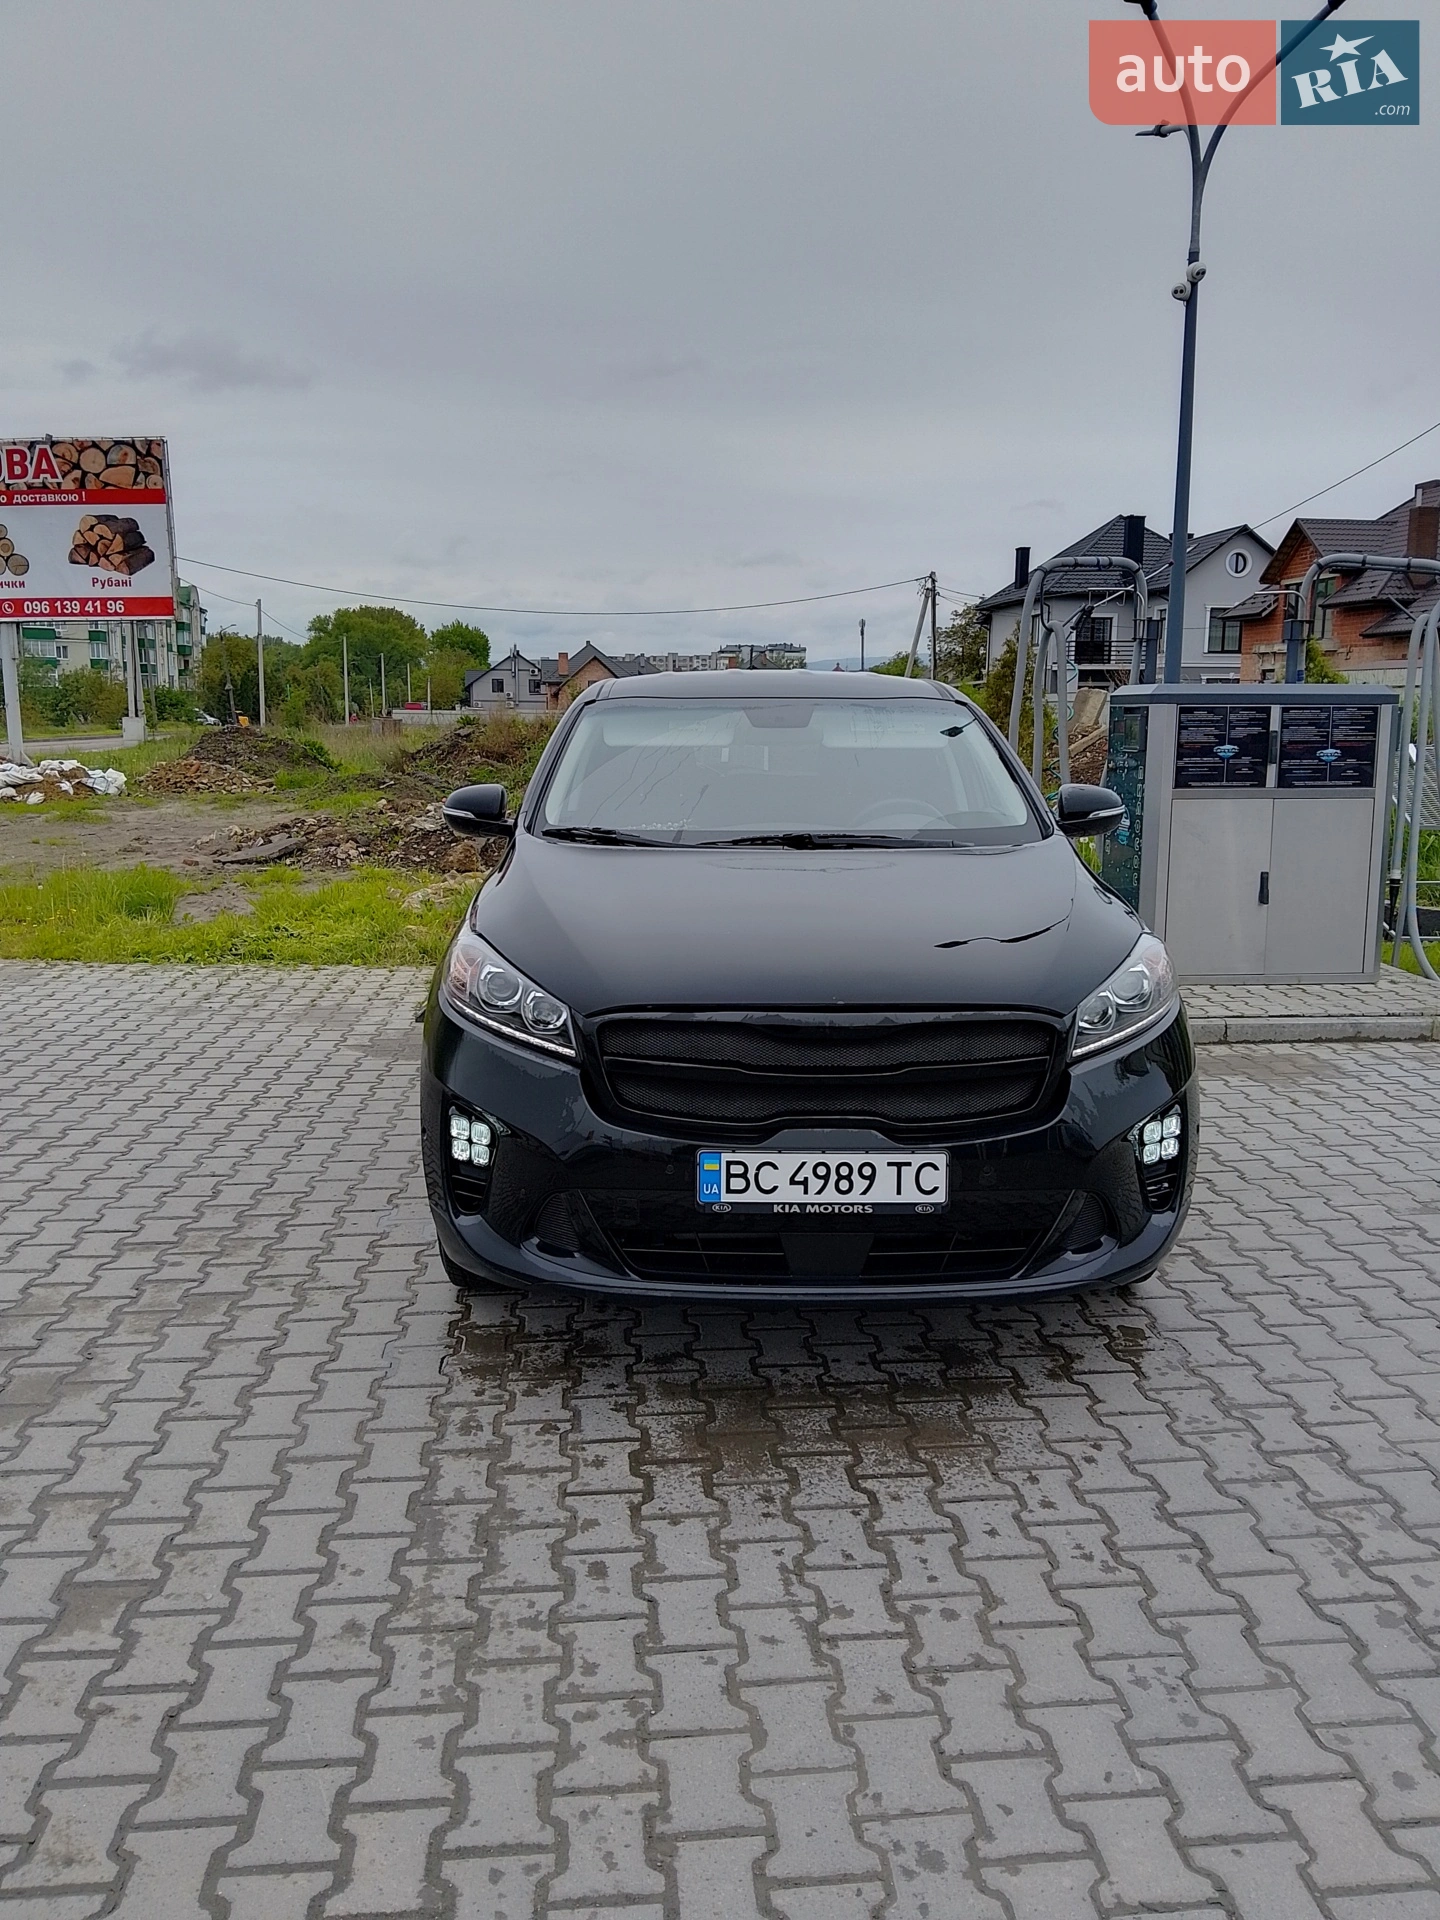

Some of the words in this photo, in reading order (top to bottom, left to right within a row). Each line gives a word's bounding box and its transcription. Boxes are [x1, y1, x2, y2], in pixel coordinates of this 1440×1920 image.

[0, 447, 60, 481] ВА
[13, 493, 79, 504] доставкою
[92, 577, 132, 589] Рубані
[23, 601, 49, 613] 096
[55, 601, 80, 613] 139
[85, 601, 101, 613] 41
[107, 600, 125, 613] 96
[725, 1159, 779, 1195] BC
[789, 1160, 877, 1196] 4989
[886, 1160, 940, 1196] TC
[703, 1184, 719, 1195] UA
[713, 1203, 731, 1211] KIA
[773, 1204, 800, 1213] KIA
[806, 1204, 873, 1213] MOTORS
[916, 1204, 933, 1212] KIA
